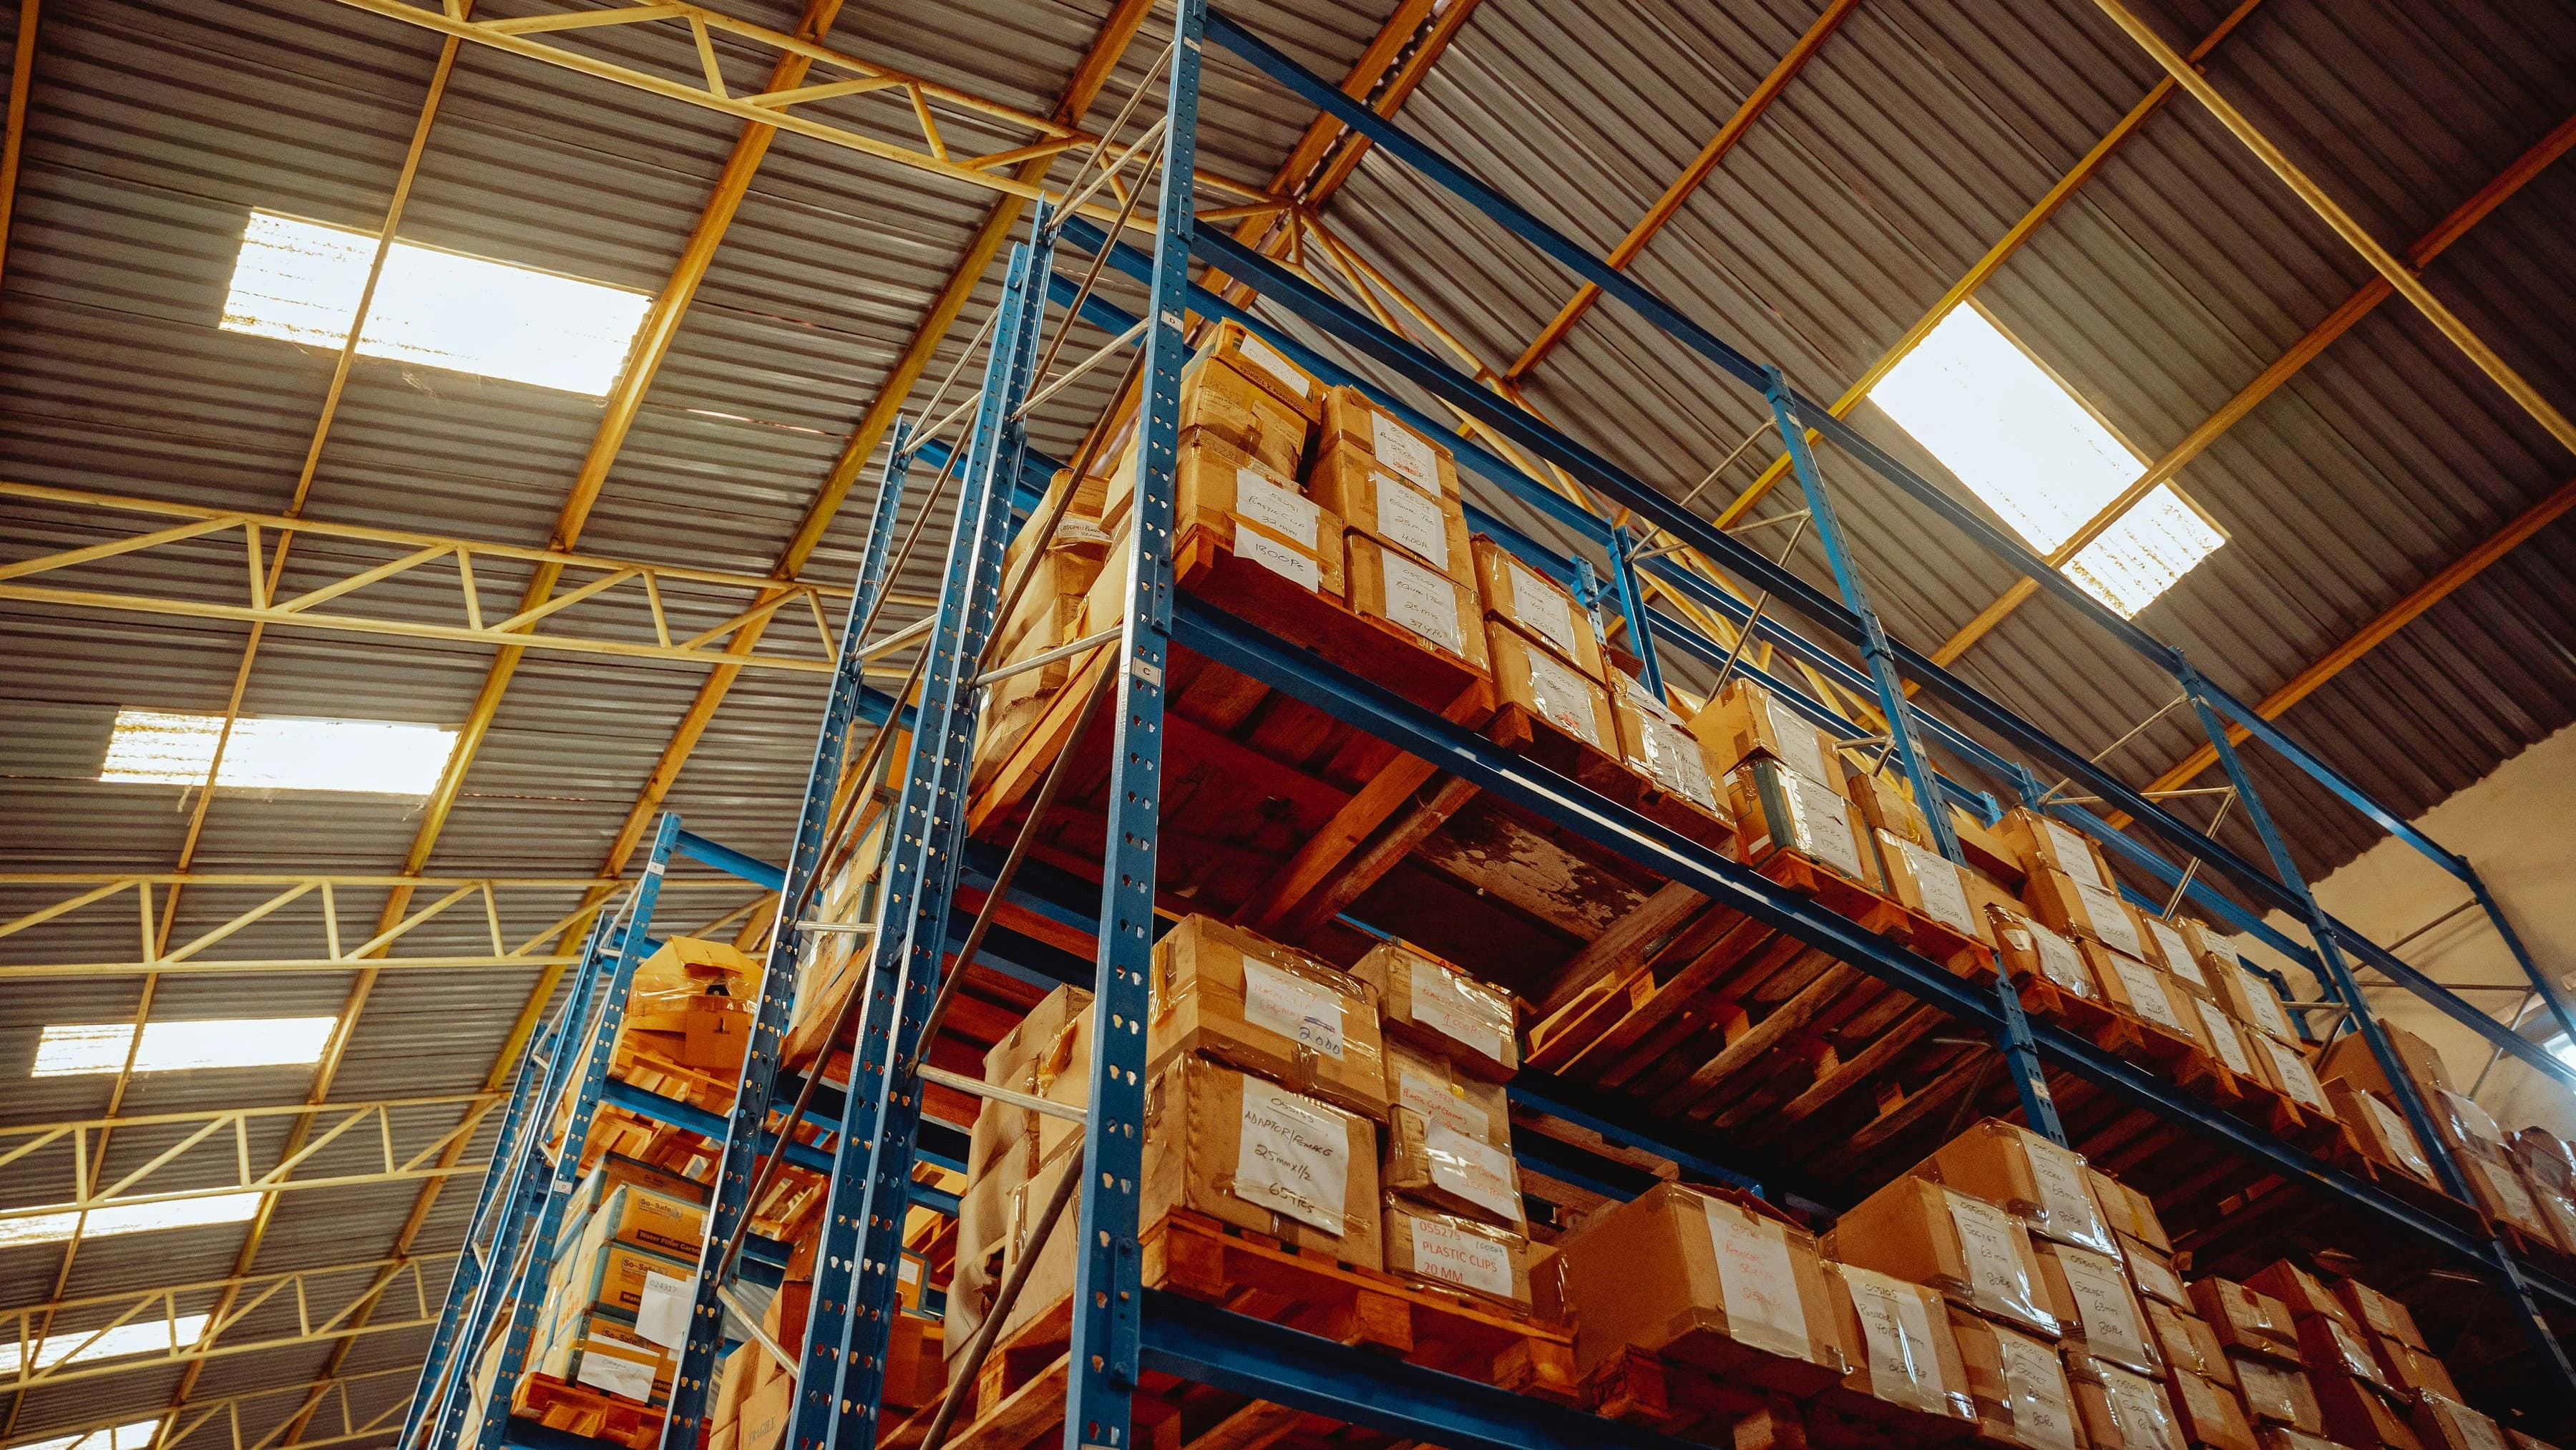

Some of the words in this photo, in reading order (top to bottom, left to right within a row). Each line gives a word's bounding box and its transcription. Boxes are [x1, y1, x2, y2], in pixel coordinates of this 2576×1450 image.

[1299, 1026, 1340, 1055] 2000
[1423, 1241, 1467, 1263] PLASTIC
[1469, 1254, 1498, 1273] CLIPS
[1423, 1262, 1438, 1276] 20
[1440, 1267, 1463, 1283] MM
